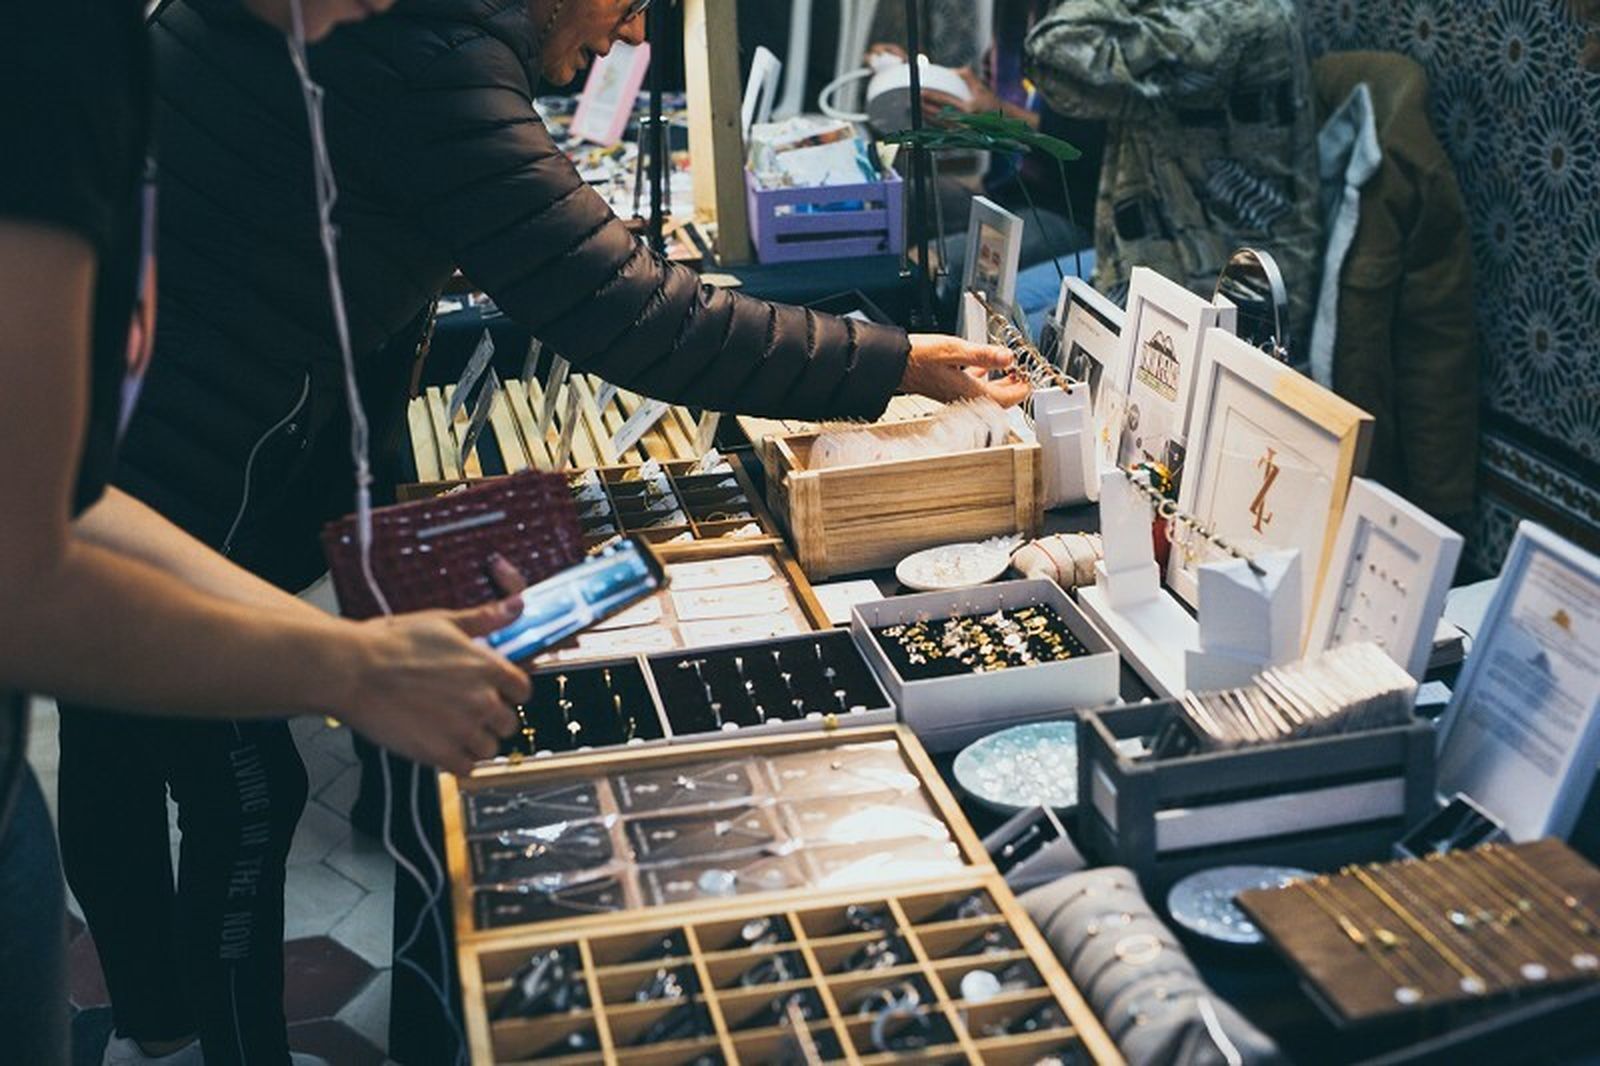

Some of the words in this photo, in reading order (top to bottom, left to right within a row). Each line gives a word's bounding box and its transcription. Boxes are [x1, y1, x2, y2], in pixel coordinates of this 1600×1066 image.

[230, 743, 271, 812] LIVING
[241, 822, 269, 848] IN
[228, 856, 263, 898] THE
[220, 911, 253, 960] NOW
